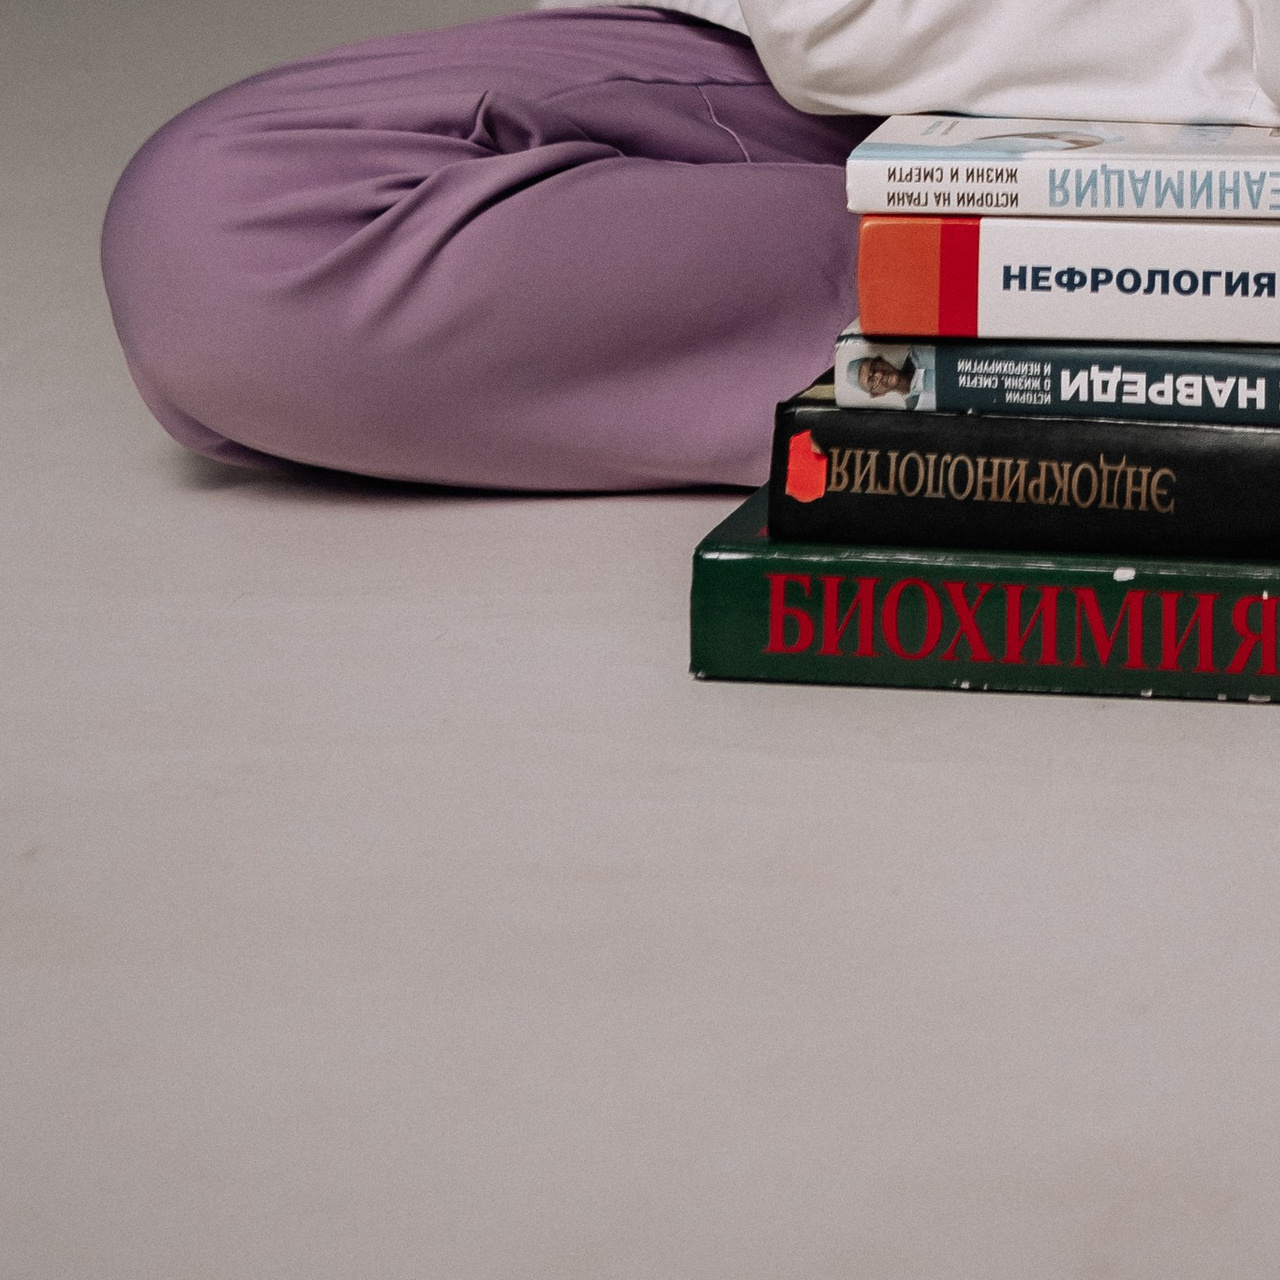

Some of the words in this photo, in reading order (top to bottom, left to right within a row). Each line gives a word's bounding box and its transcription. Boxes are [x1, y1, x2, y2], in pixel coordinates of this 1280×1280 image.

[887, 166, 944, 183] СМЕРТИ
[950, 167, 959, 184] И
[965, 167, 1018, 184] ЖИЗНИ
[886, 191, 928, 207] ГРАНИ
[933, 192, 951, 207] НА
[956, 192, 1019, 208] ИСТОРИИ
[1002, 265, 1276, 298] НЕФРОЛОГИЯ
[957, 358, 1041, 378] НЕЙРОХИРУРГИИ
[1043, 361, 1052, 377] И
[958, 374, 999, 389] СМЕРТИ
[1001, 375, 1041, 391] ЖИЗНИ,
[1044, 377, 1051, 391] О
[1060, 364, 1266, 410] НАВРЕДИ
[1005, 390, 1052, 405] ИСТОРИИ
[826, 446, 1177, 514] ЭНДОКРИНОЛОГИЯ
